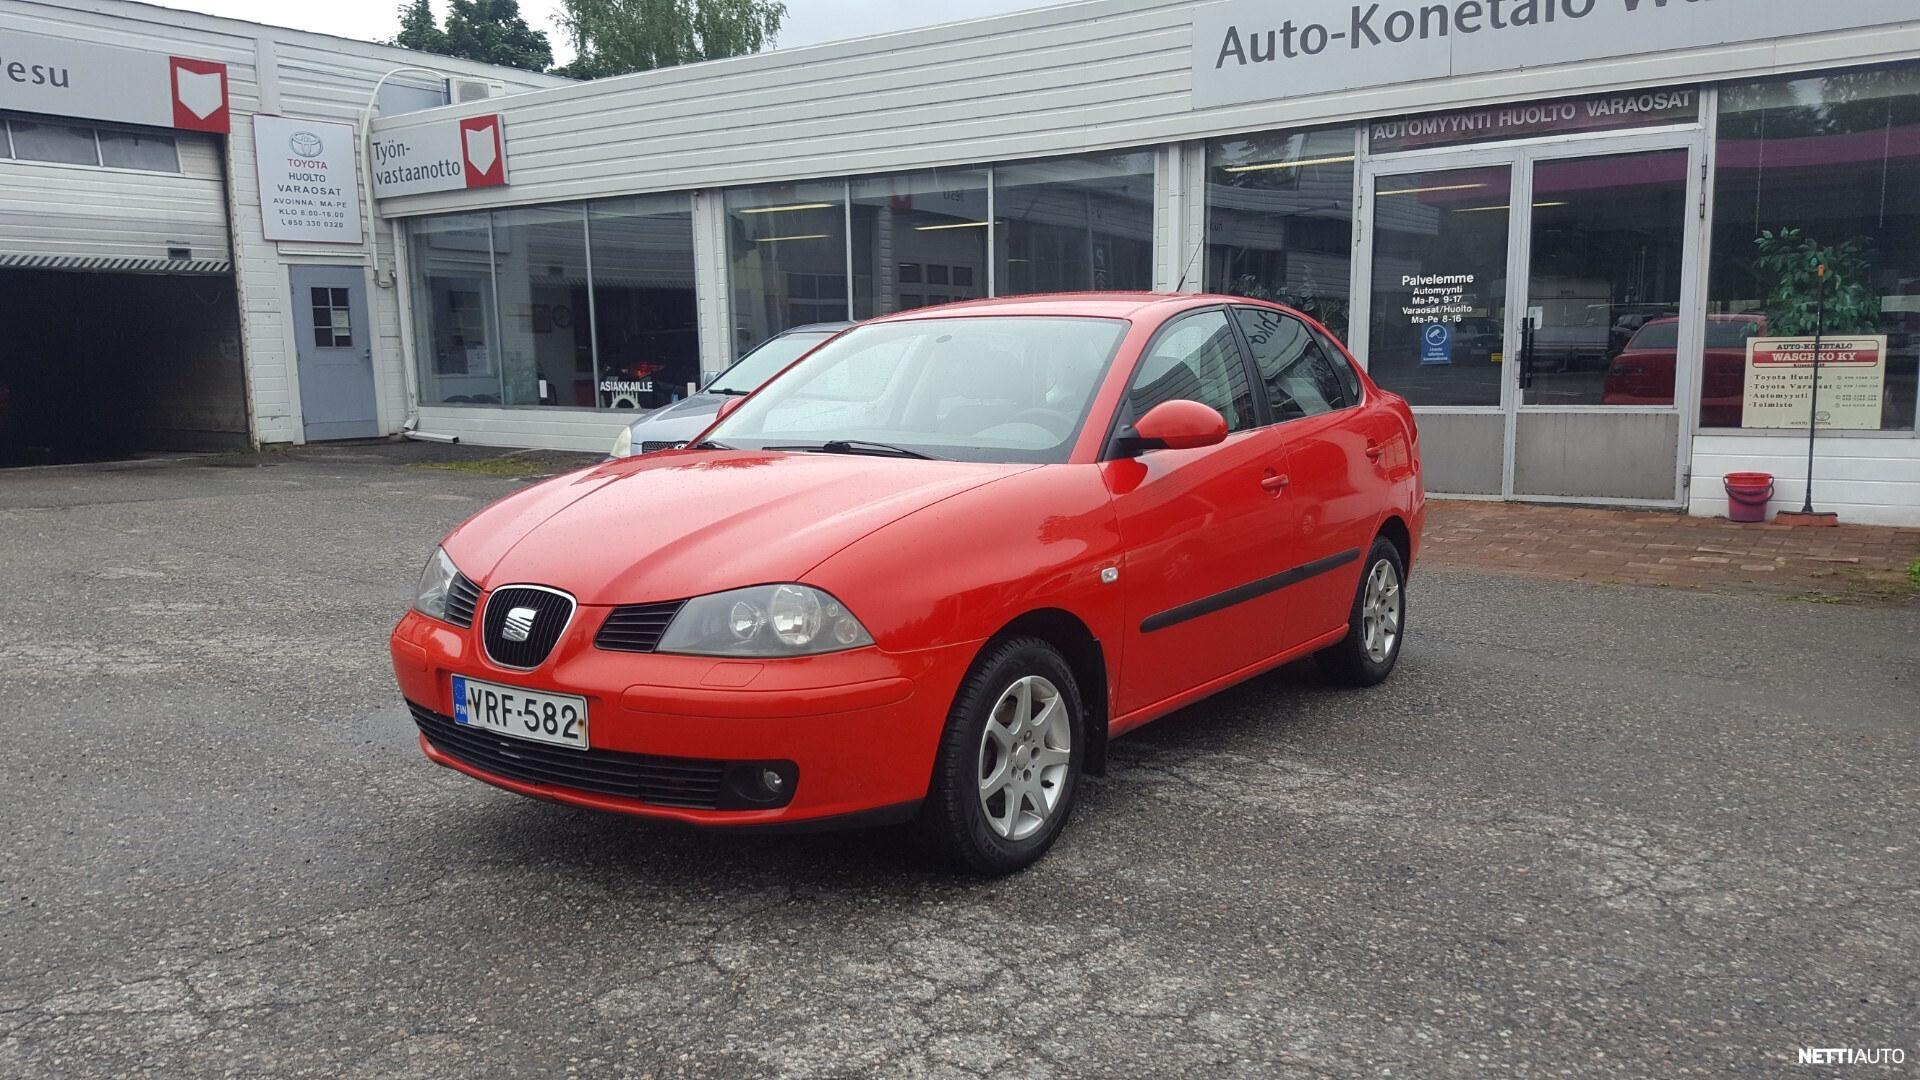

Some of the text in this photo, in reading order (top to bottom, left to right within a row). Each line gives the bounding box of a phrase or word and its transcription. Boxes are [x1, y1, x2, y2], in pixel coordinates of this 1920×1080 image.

[0, 57, 69, 88] esu
[1373, 90, 1694, 140] AUTOMYYNTI HUOLTO VARAOSAT
[372, 140, 410, 166] Työn-
[287, 158, 328, 170] TOYOTA
[288, 172, 326, 183] HUOLTO
[376, 159, 460, 185] vastaanotto
[277, 184, 342, 196] VARAOSAT
[273, 197, 317, 206] AVOINNA:
[279, 208, 297, 216] KLO
[1402, 274, 1474, 286] Palvelemme
[1413, 285, 1463, 296] Automyynti
[1412, 295, 1462, 305] Ma-Pe 9-17
[1402, 305, 1473, 315] Varaosat/Huolto
[1411, 314, 1462, 324] Ma-Pe 8-16
[1776, 342, 1853, 351] AUTO-KONETALO
[1772, 352, 1857, 361] WASCHKO KY
[600, 381, 654, 392] ASIAKKAILLE
[456, 686, 579, 740] FIN VRF-582
